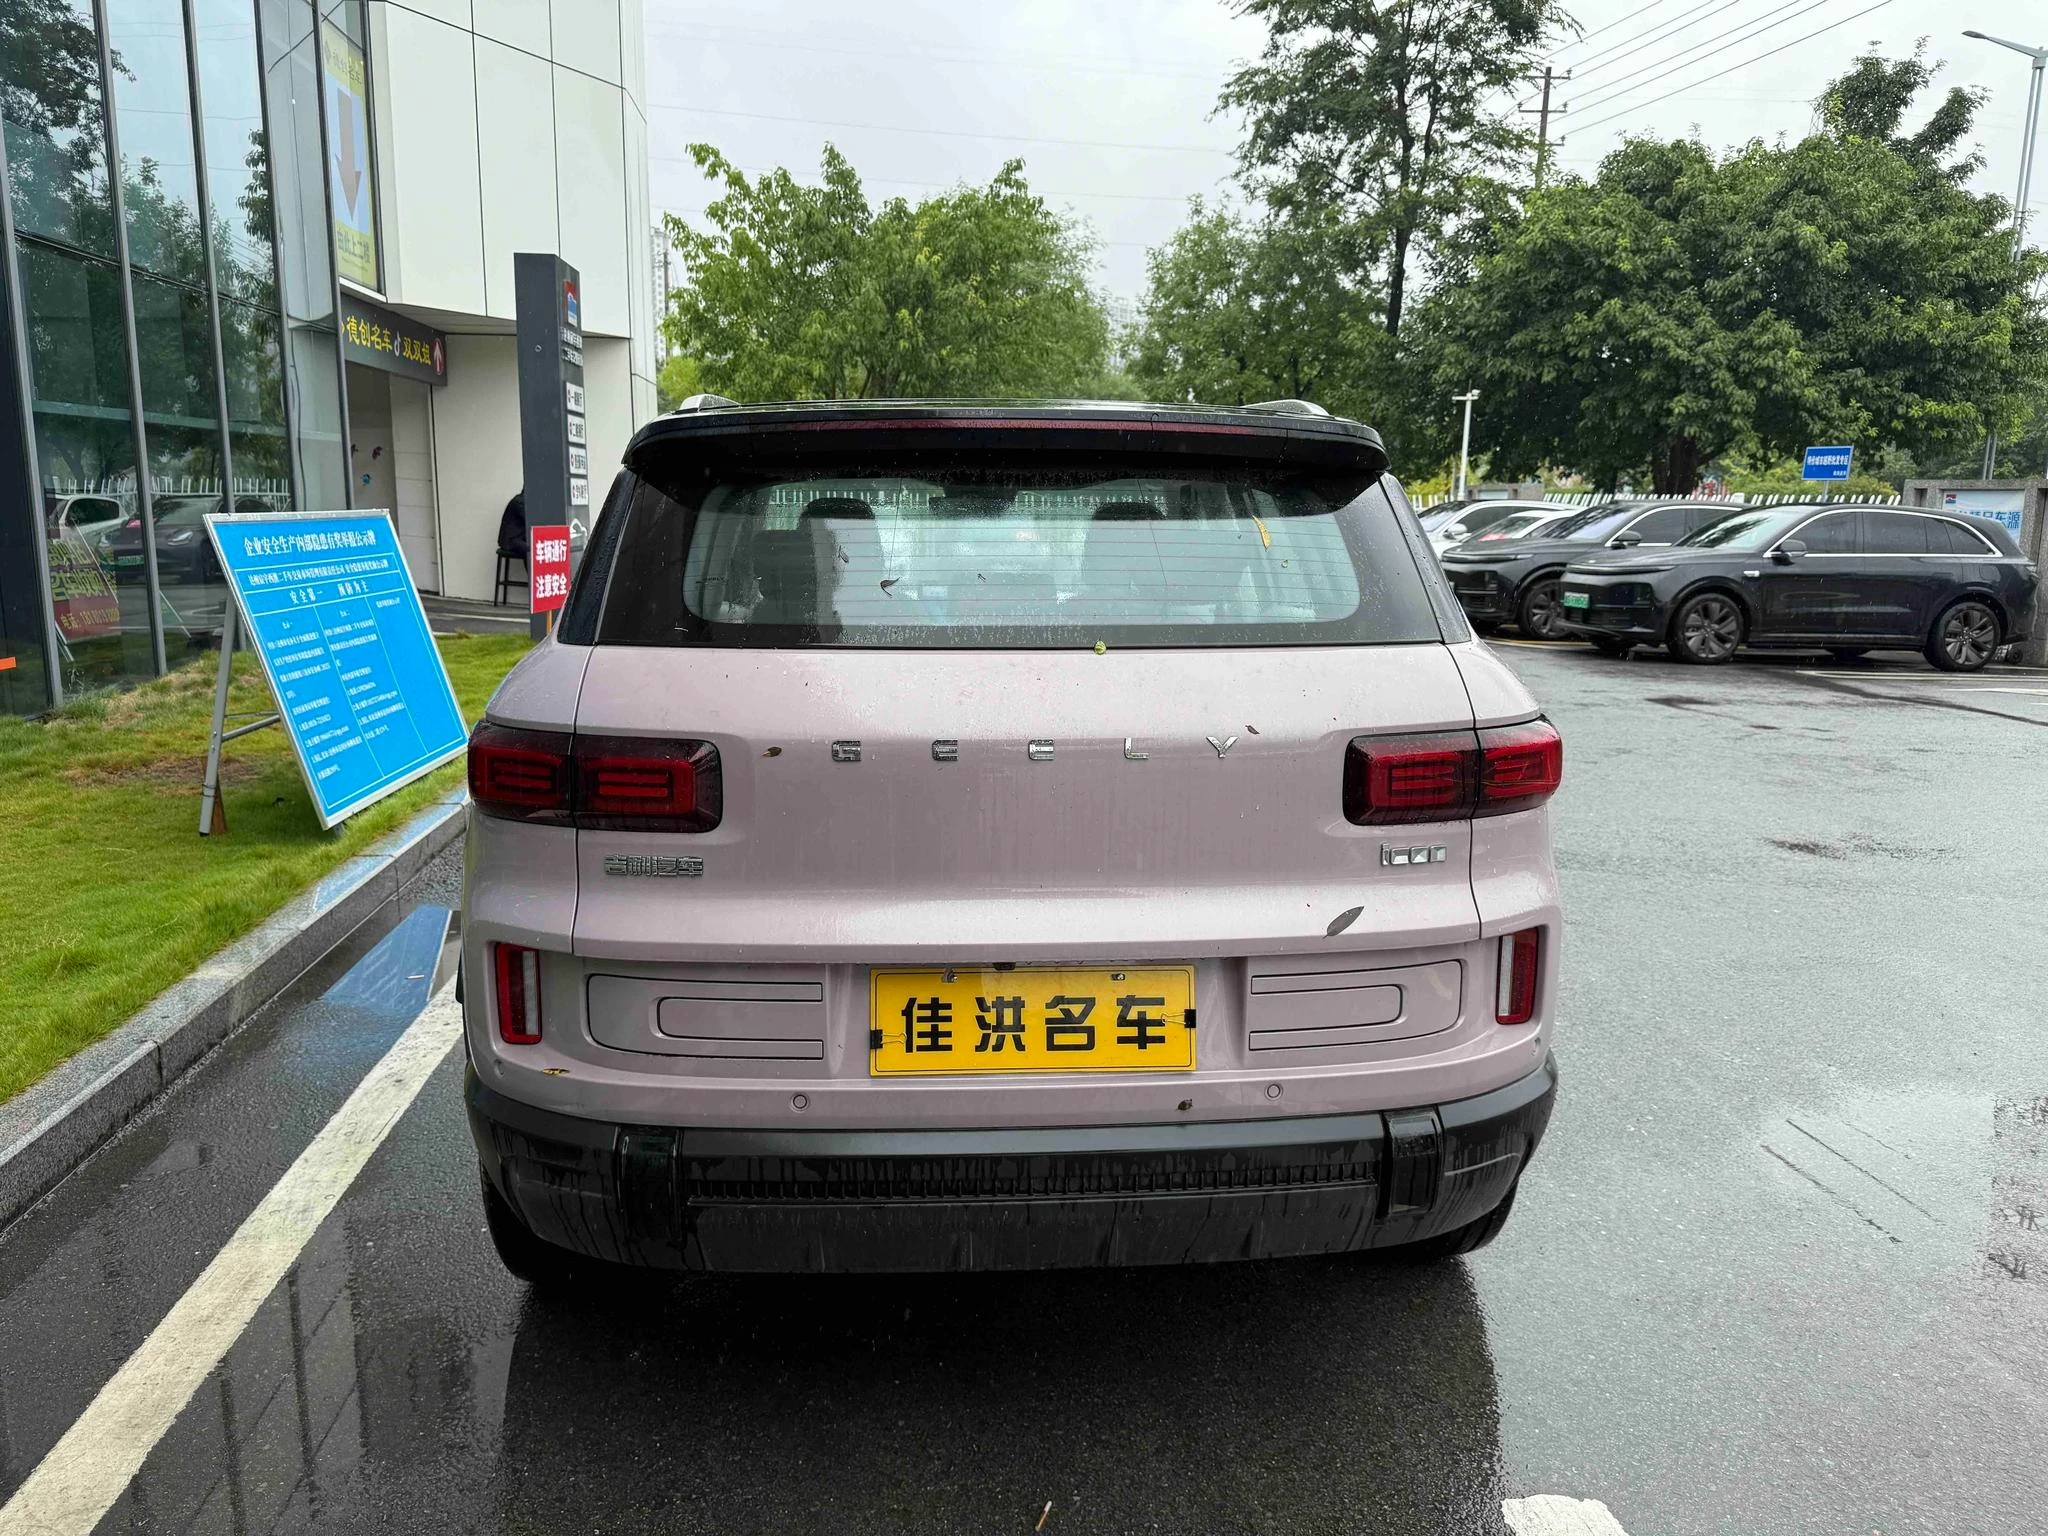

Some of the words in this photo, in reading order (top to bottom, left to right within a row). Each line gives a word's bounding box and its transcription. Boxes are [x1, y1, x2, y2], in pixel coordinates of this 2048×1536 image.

[346, 315, 392, 353] 德创名车
[536, 540, 567, 563] 车辆通行
[289, 583, 323, 604] 安全第一
[536, 573, 567, 598] 注意安全
[831, 736, 1240, 762] GEELY
[604, 854, 703, 876] 吉利汽车
[901, 995, 1165, 1053] 佳洪名车
